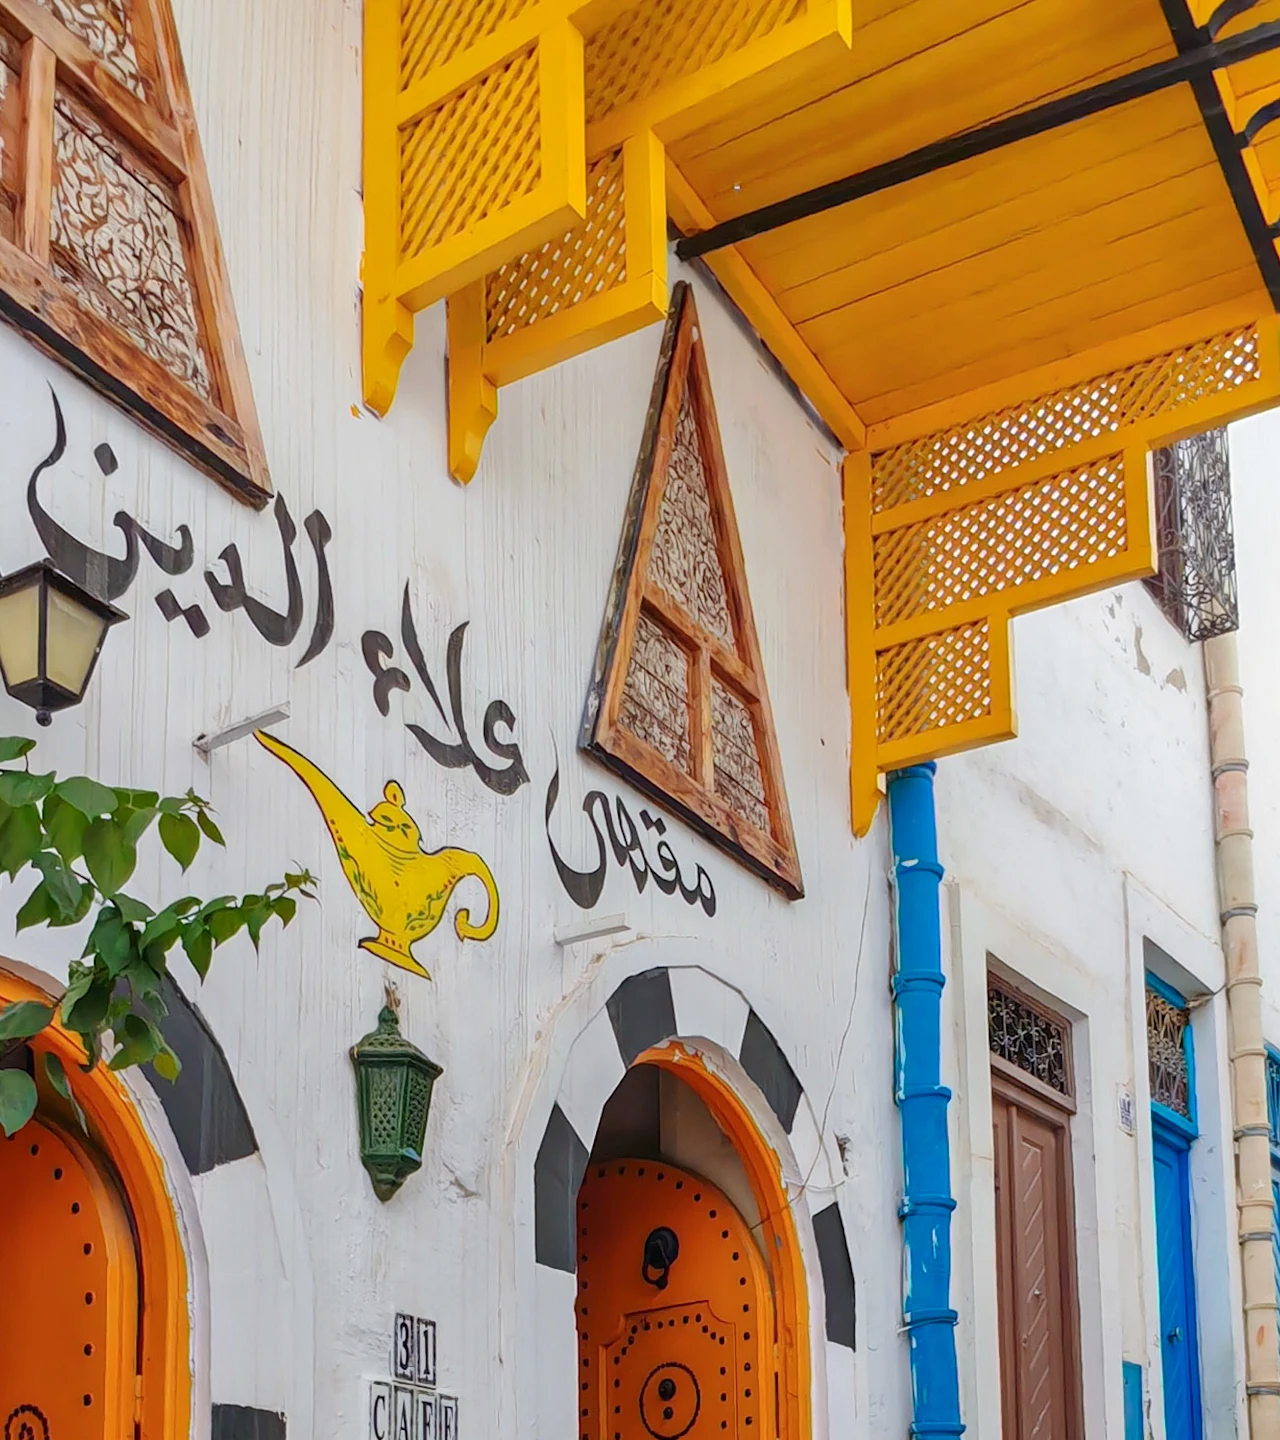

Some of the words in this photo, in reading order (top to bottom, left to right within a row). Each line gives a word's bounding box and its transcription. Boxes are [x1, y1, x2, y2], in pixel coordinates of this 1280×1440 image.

[27, 378, 334, 669] الدين
[361, 576, 530, 796] علاء
[399, 1322, 430, 1375] 31
